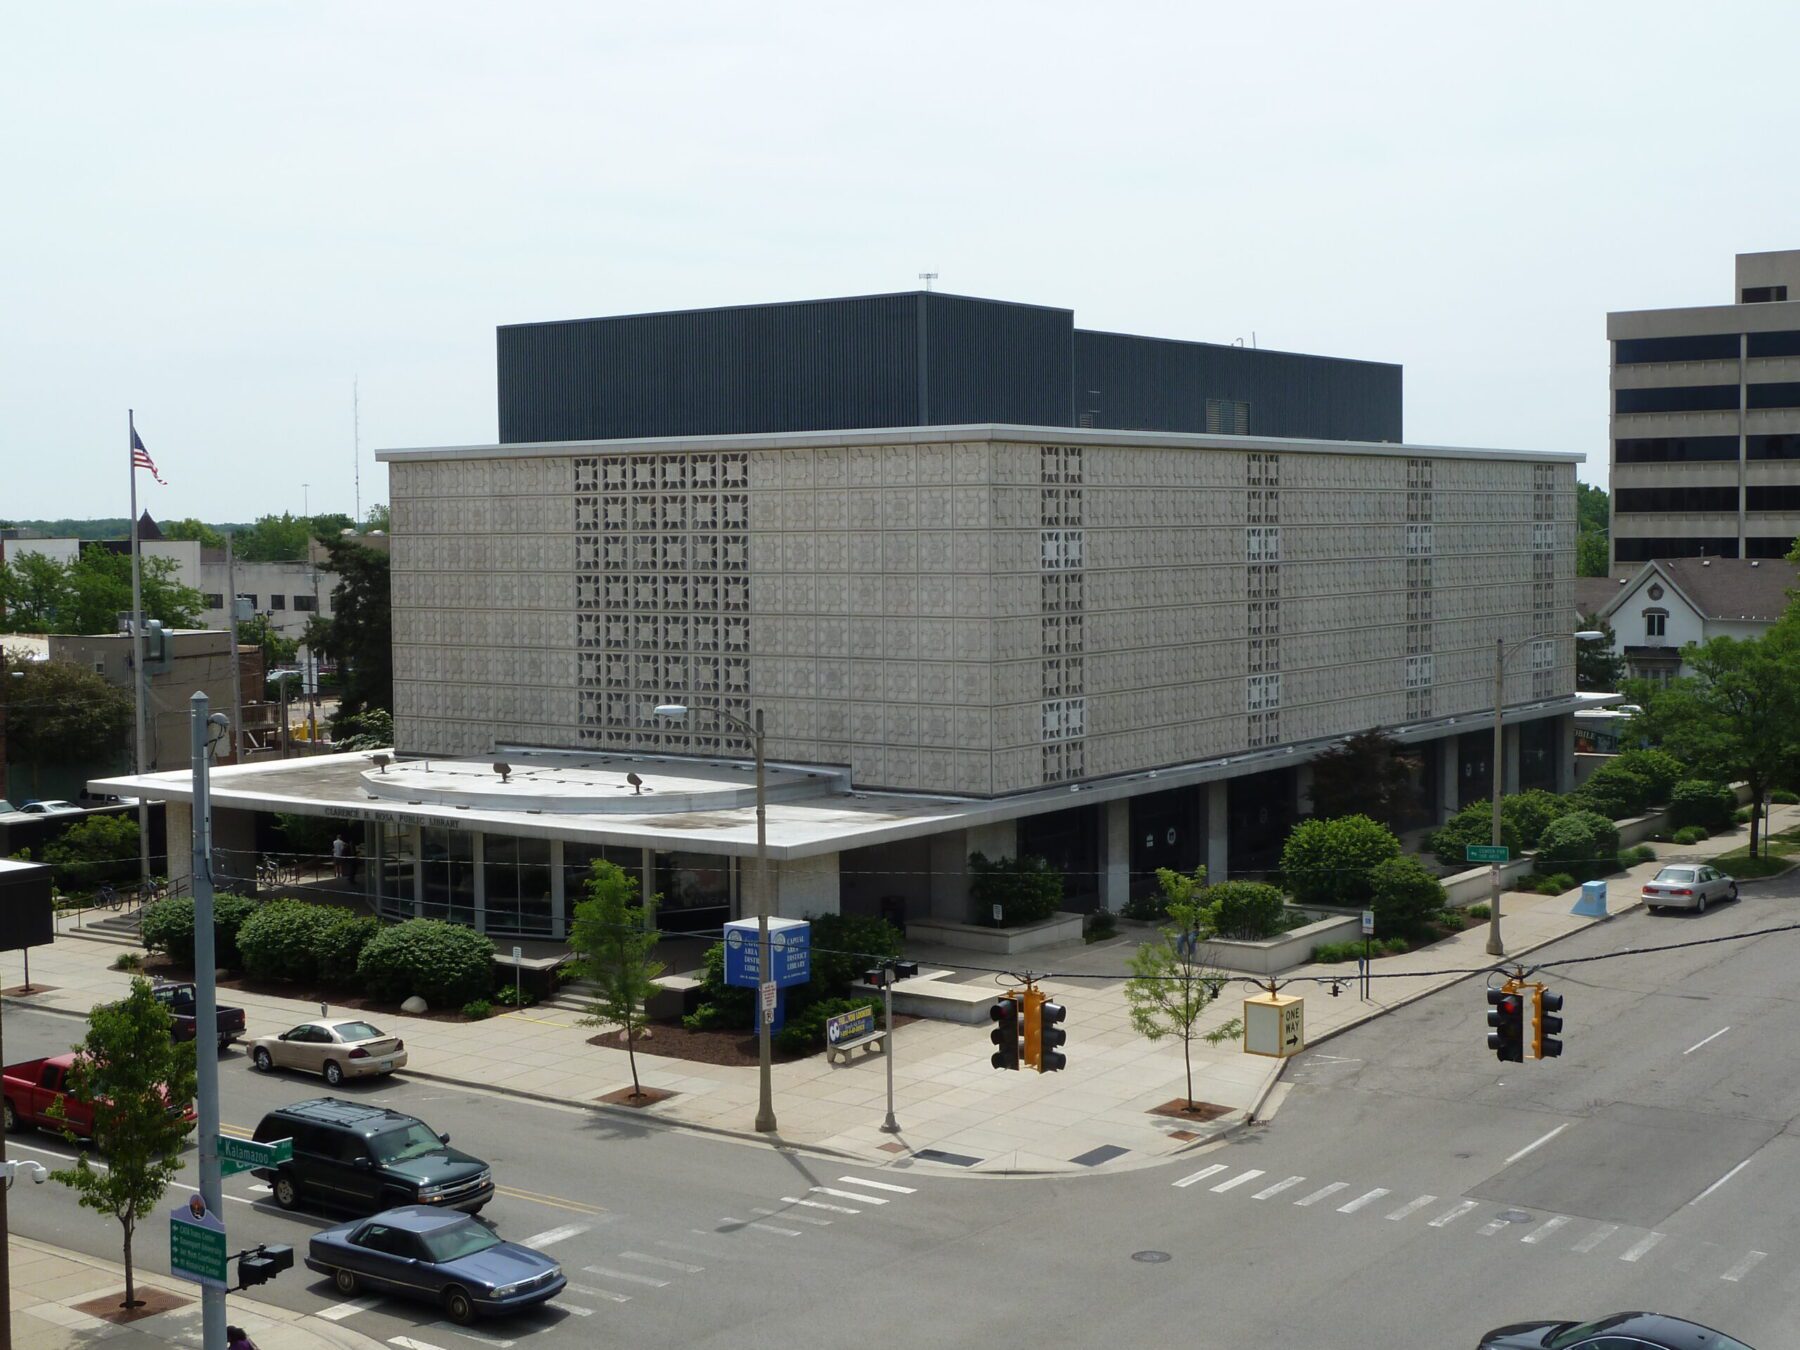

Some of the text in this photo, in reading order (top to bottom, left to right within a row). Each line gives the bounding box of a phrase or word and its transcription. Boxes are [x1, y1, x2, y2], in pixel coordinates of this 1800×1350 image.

[324, 807, 359, 818] CLARENCE
[399, 814, 425, 825] PUBLIC
[429, 817, 460, 829] LIBRARY
[744, 947, 758, 957] AREA
[787, 951, 807, 962] DISTRICT
[744, 955, 760, 965] DISTR
[787, 960, 805, 971] LIBRARY
[744, 964, 760, 973] LIBRA
[1286, 1007, 1300, 1022] ONE
[1286, 1020, 1300, 1035] WAY
[225, 1140, 269, 1165] Kalamazoo
